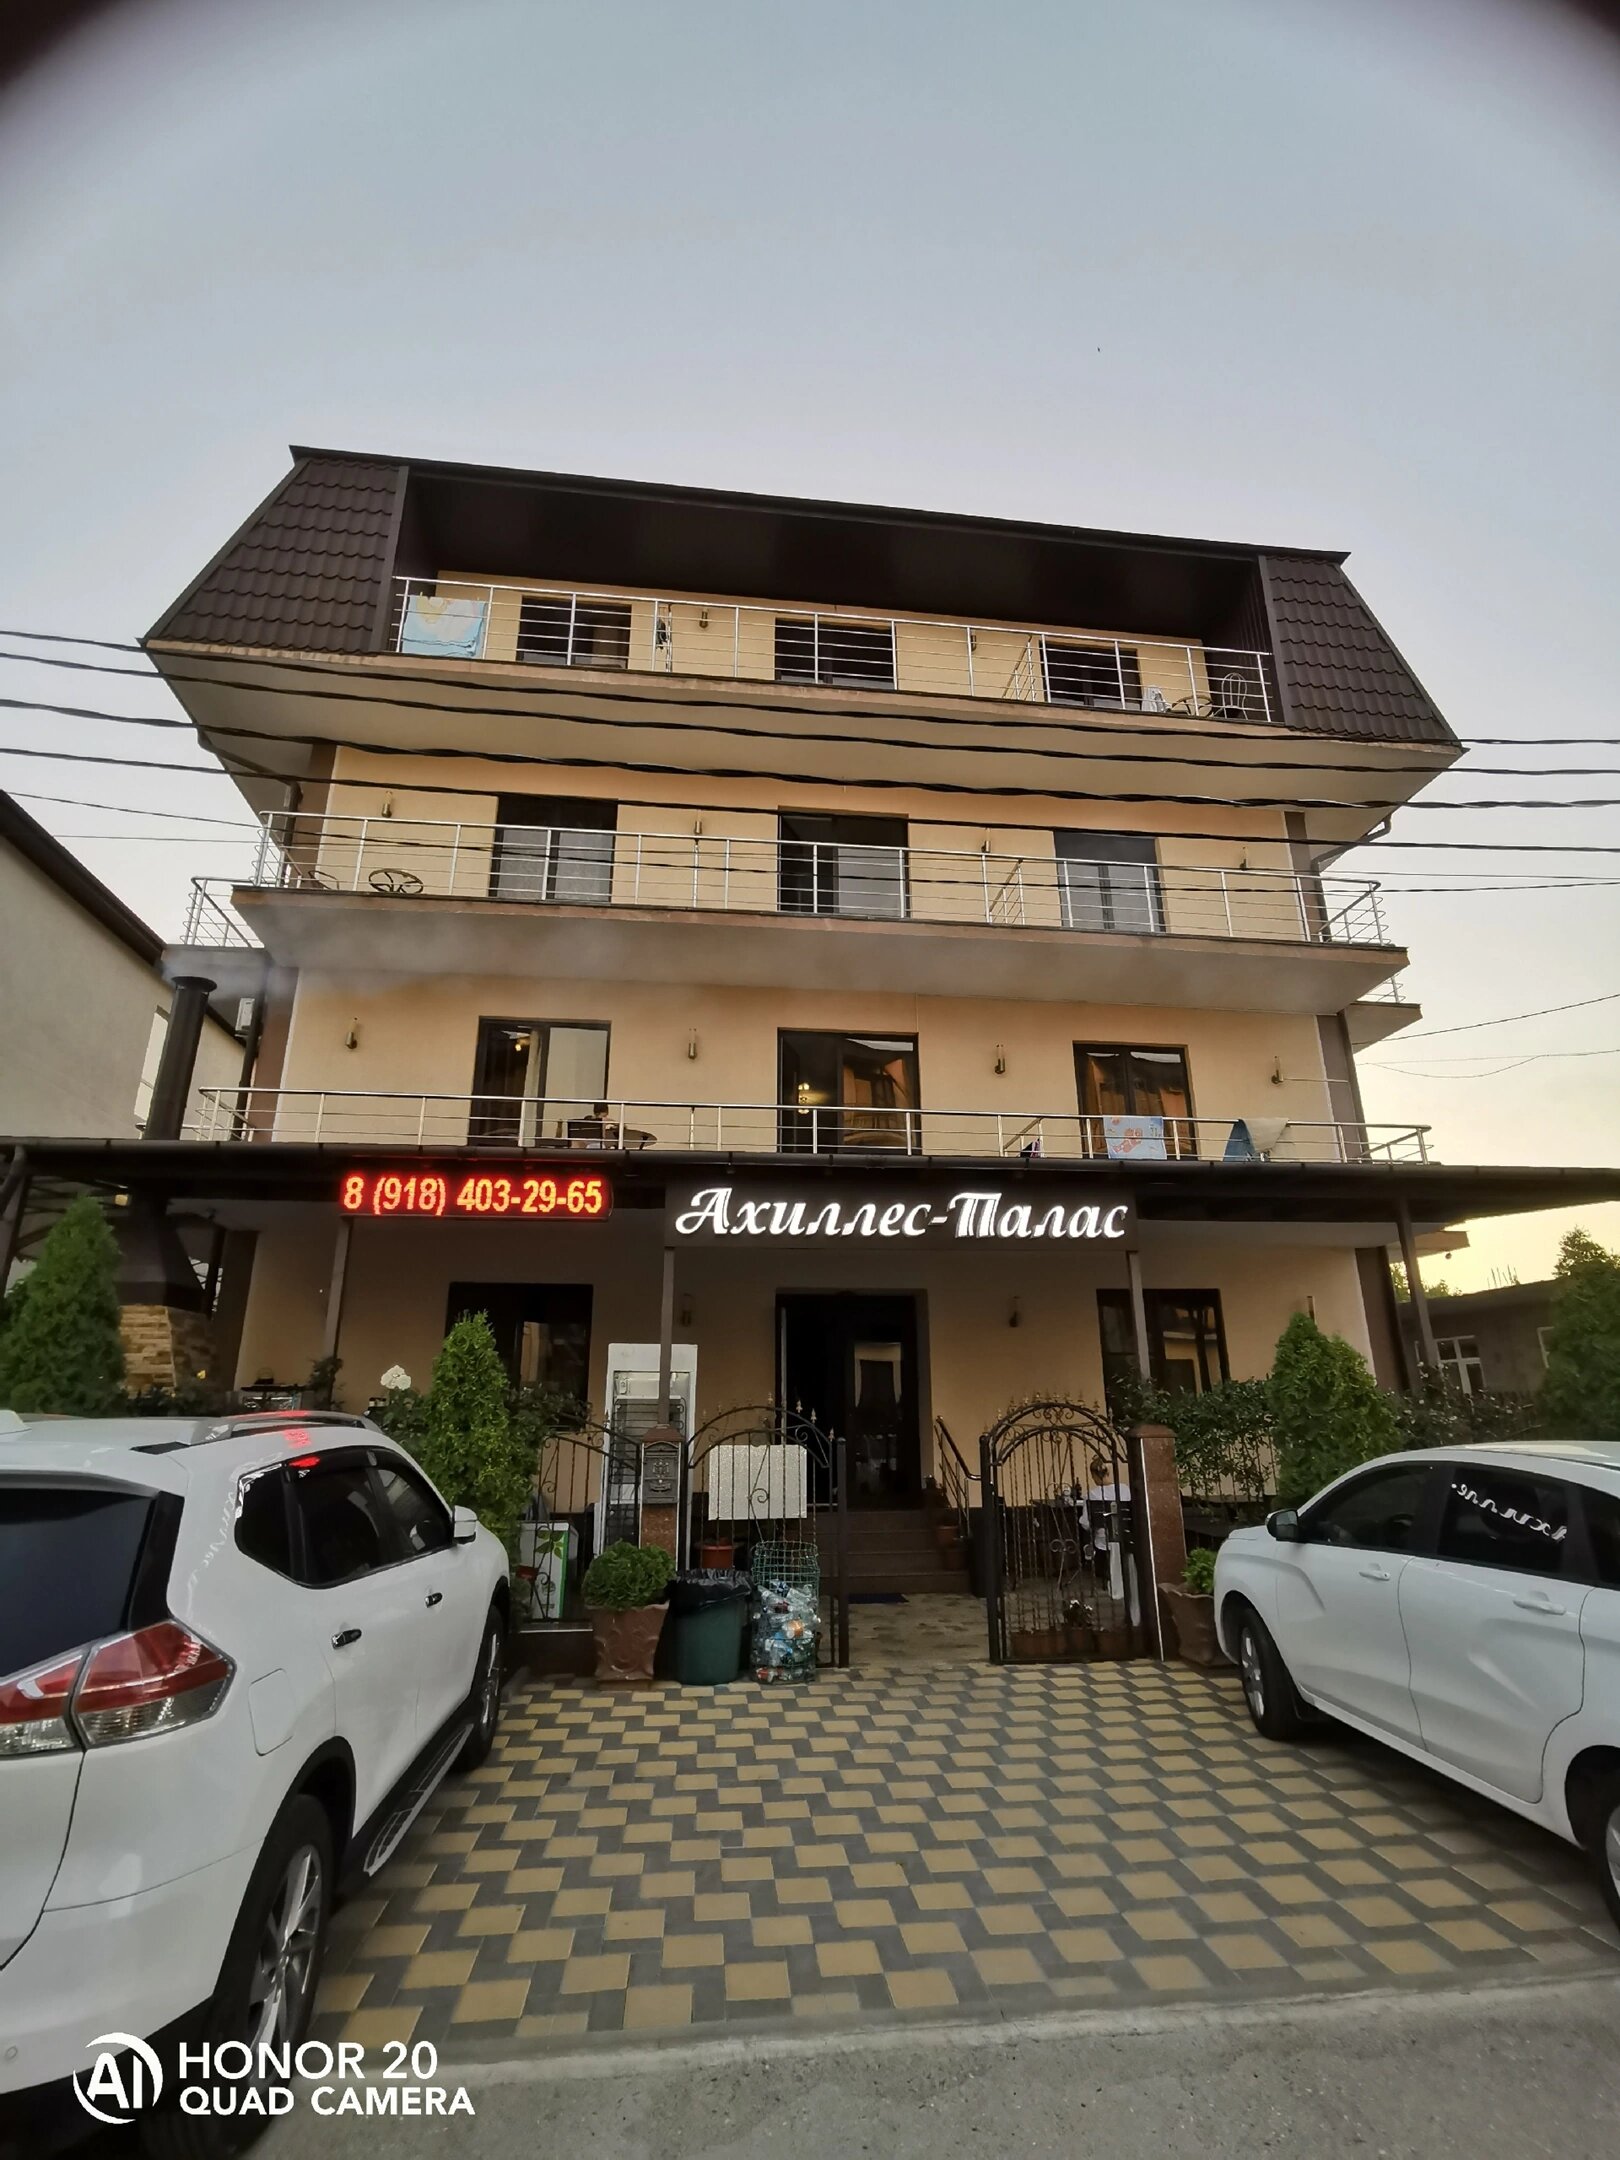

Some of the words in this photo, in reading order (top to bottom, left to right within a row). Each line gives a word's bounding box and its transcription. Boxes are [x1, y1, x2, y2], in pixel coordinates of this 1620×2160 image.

[343, 1176, 364, 1209] 8
[373, 1177, 446, 1215] (918)
[456, 1178, 602, 1213] 403-29-65
[675, 1187, 1129, 1238] Ахиллес-Палас
